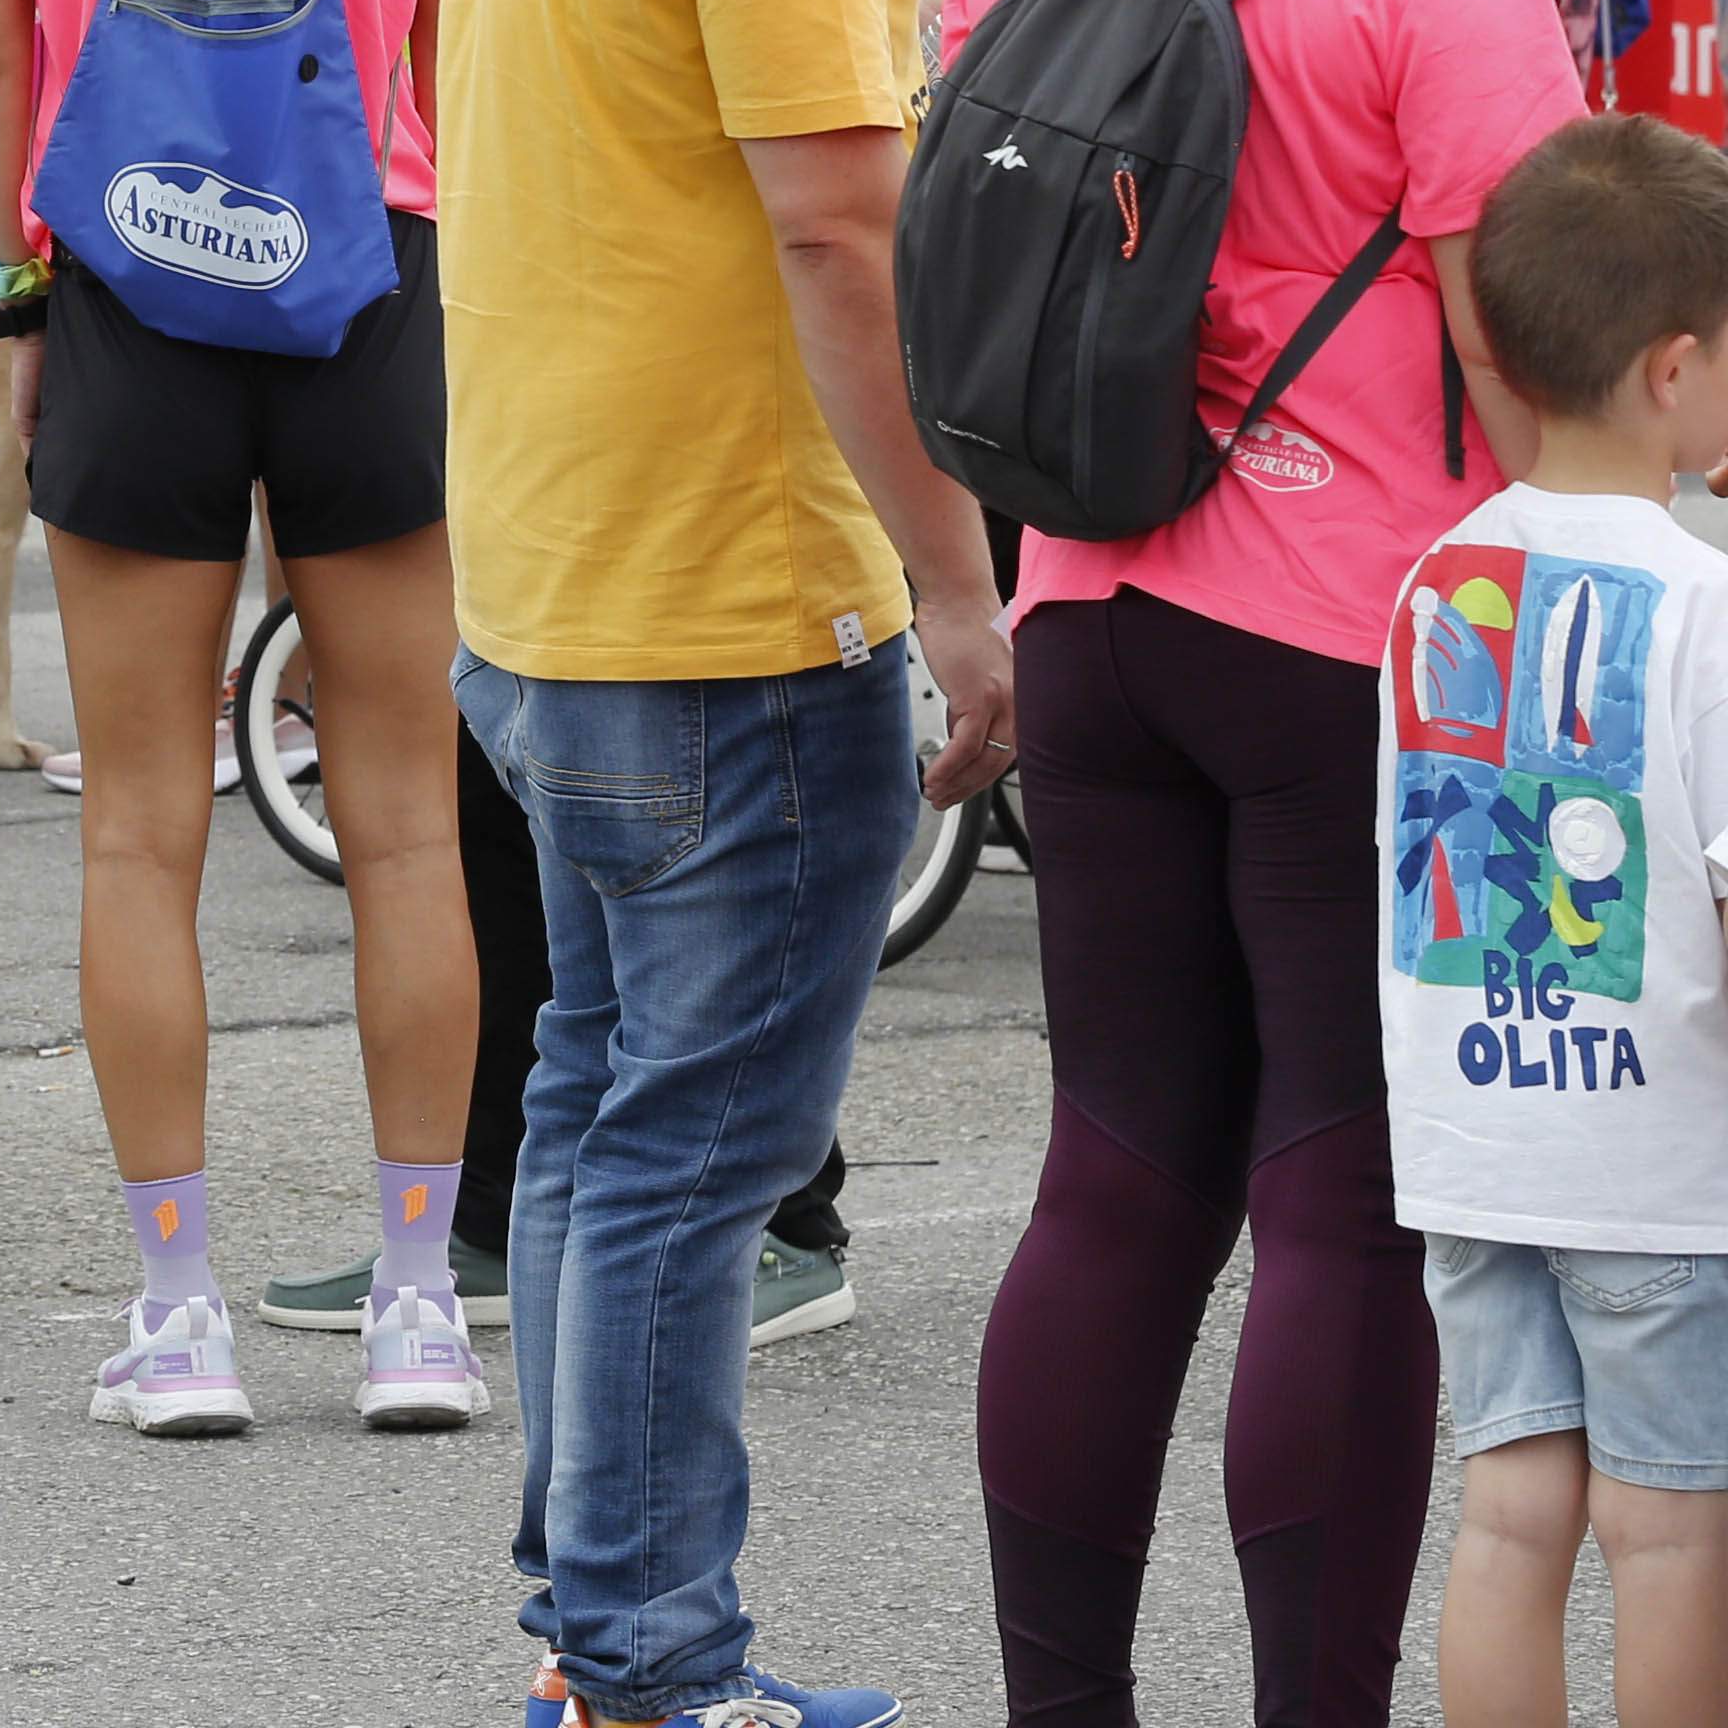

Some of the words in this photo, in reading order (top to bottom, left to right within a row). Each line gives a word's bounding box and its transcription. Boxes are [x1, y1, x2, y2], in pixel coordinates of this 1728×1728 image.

[117, 183, 292, 266] ASTURIANA
[150, 188, 217, 220] CENTRAL
[1483, 948, 1575, 1021] BIG
[1458, 1021, 1646, 1092] OLITA
